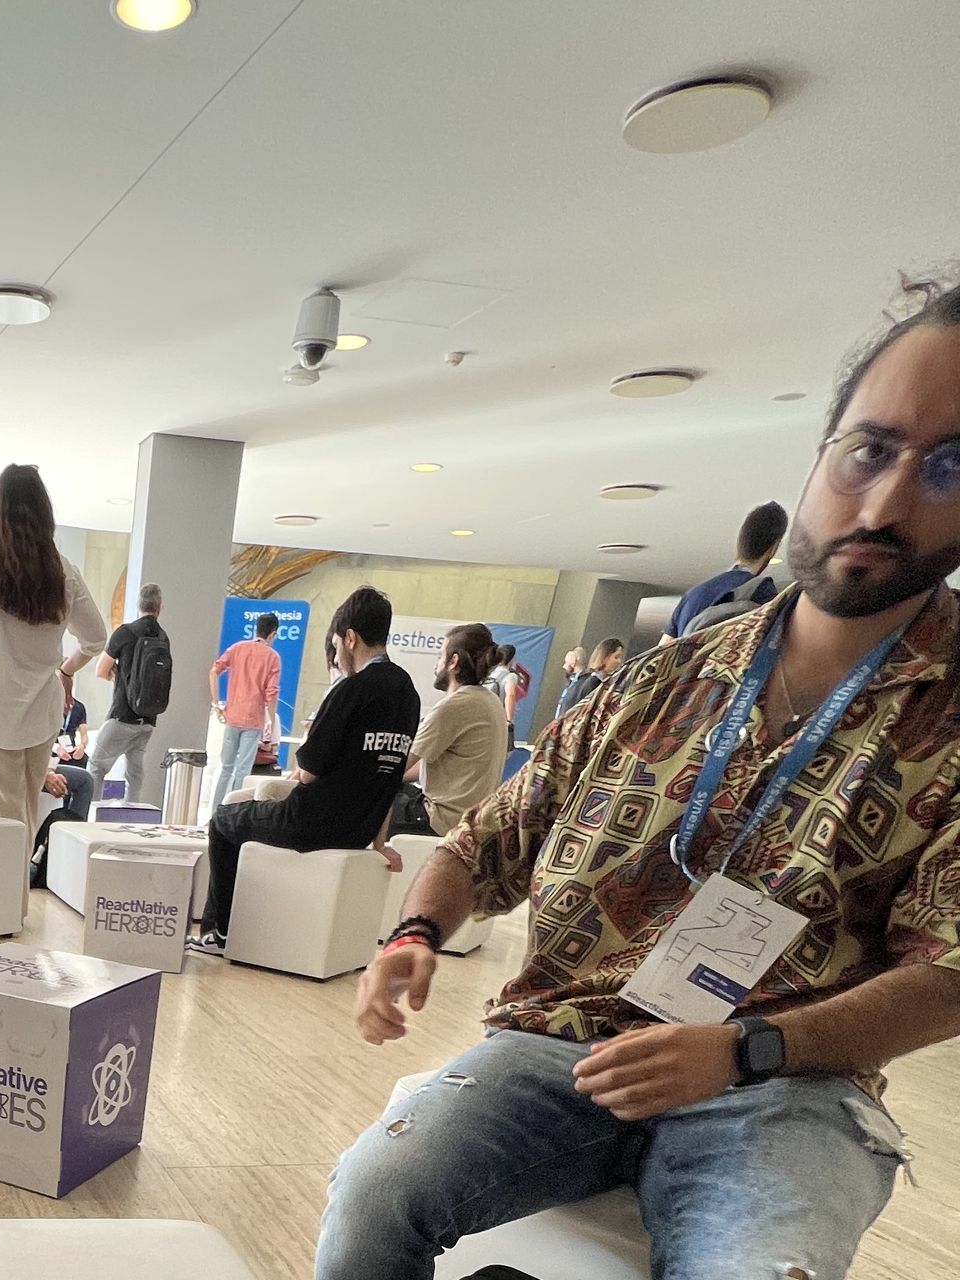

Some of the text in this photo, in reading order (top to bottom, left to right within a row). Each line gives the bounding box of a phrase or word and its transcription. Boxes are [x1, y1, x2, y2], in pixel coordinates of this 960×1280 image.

[243, 623, 301, 641] sce
[96, 896, 179, 917] ReactNative
[94, 911, 177, 937] HEROES
